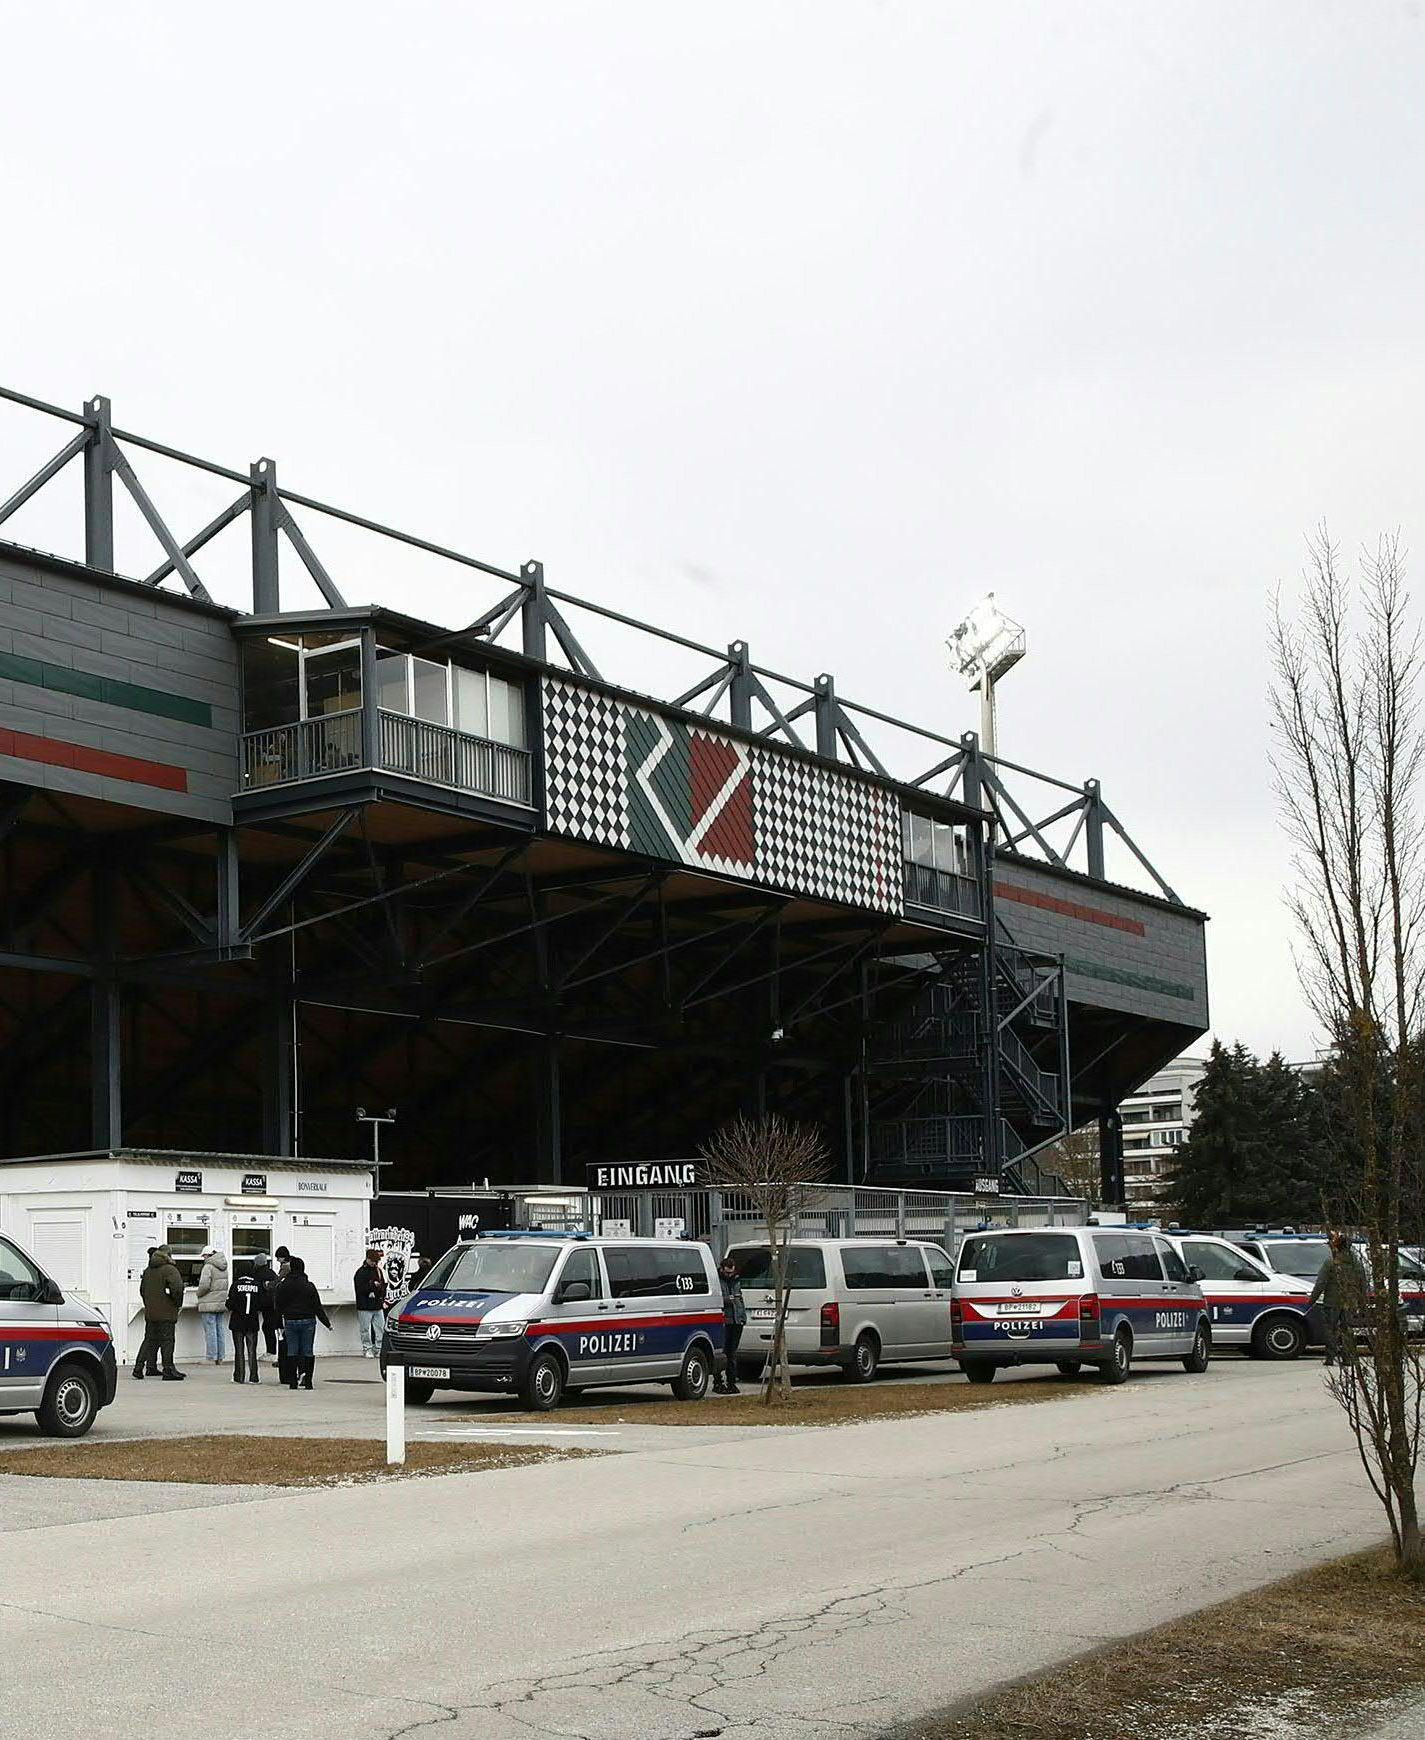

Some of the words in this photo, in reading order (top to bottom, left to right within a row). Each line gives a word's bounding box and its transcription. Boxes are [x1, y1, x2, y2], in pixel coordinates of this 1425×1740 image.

[179, 1175, 198, 1184] KASSA
[245, 1177, 263, 1186] KASSA
[597, 1164, 695, 1187] EINGANG
[975, 1178, 999, 1194] AUSGANG
[458, 1214, 479, 1231] WAC
[681, 1277, 694, 1290] 133
[246, 1293, 251, 1315] 1
[416, 1299, 485, 1309] POLIZEI
[994, 1321, 1044, 1331] POLIZEI
[1156, 1312, 1186, 1328] POLIZEI
[579, 1333, 637, 1354] POLIZEI
